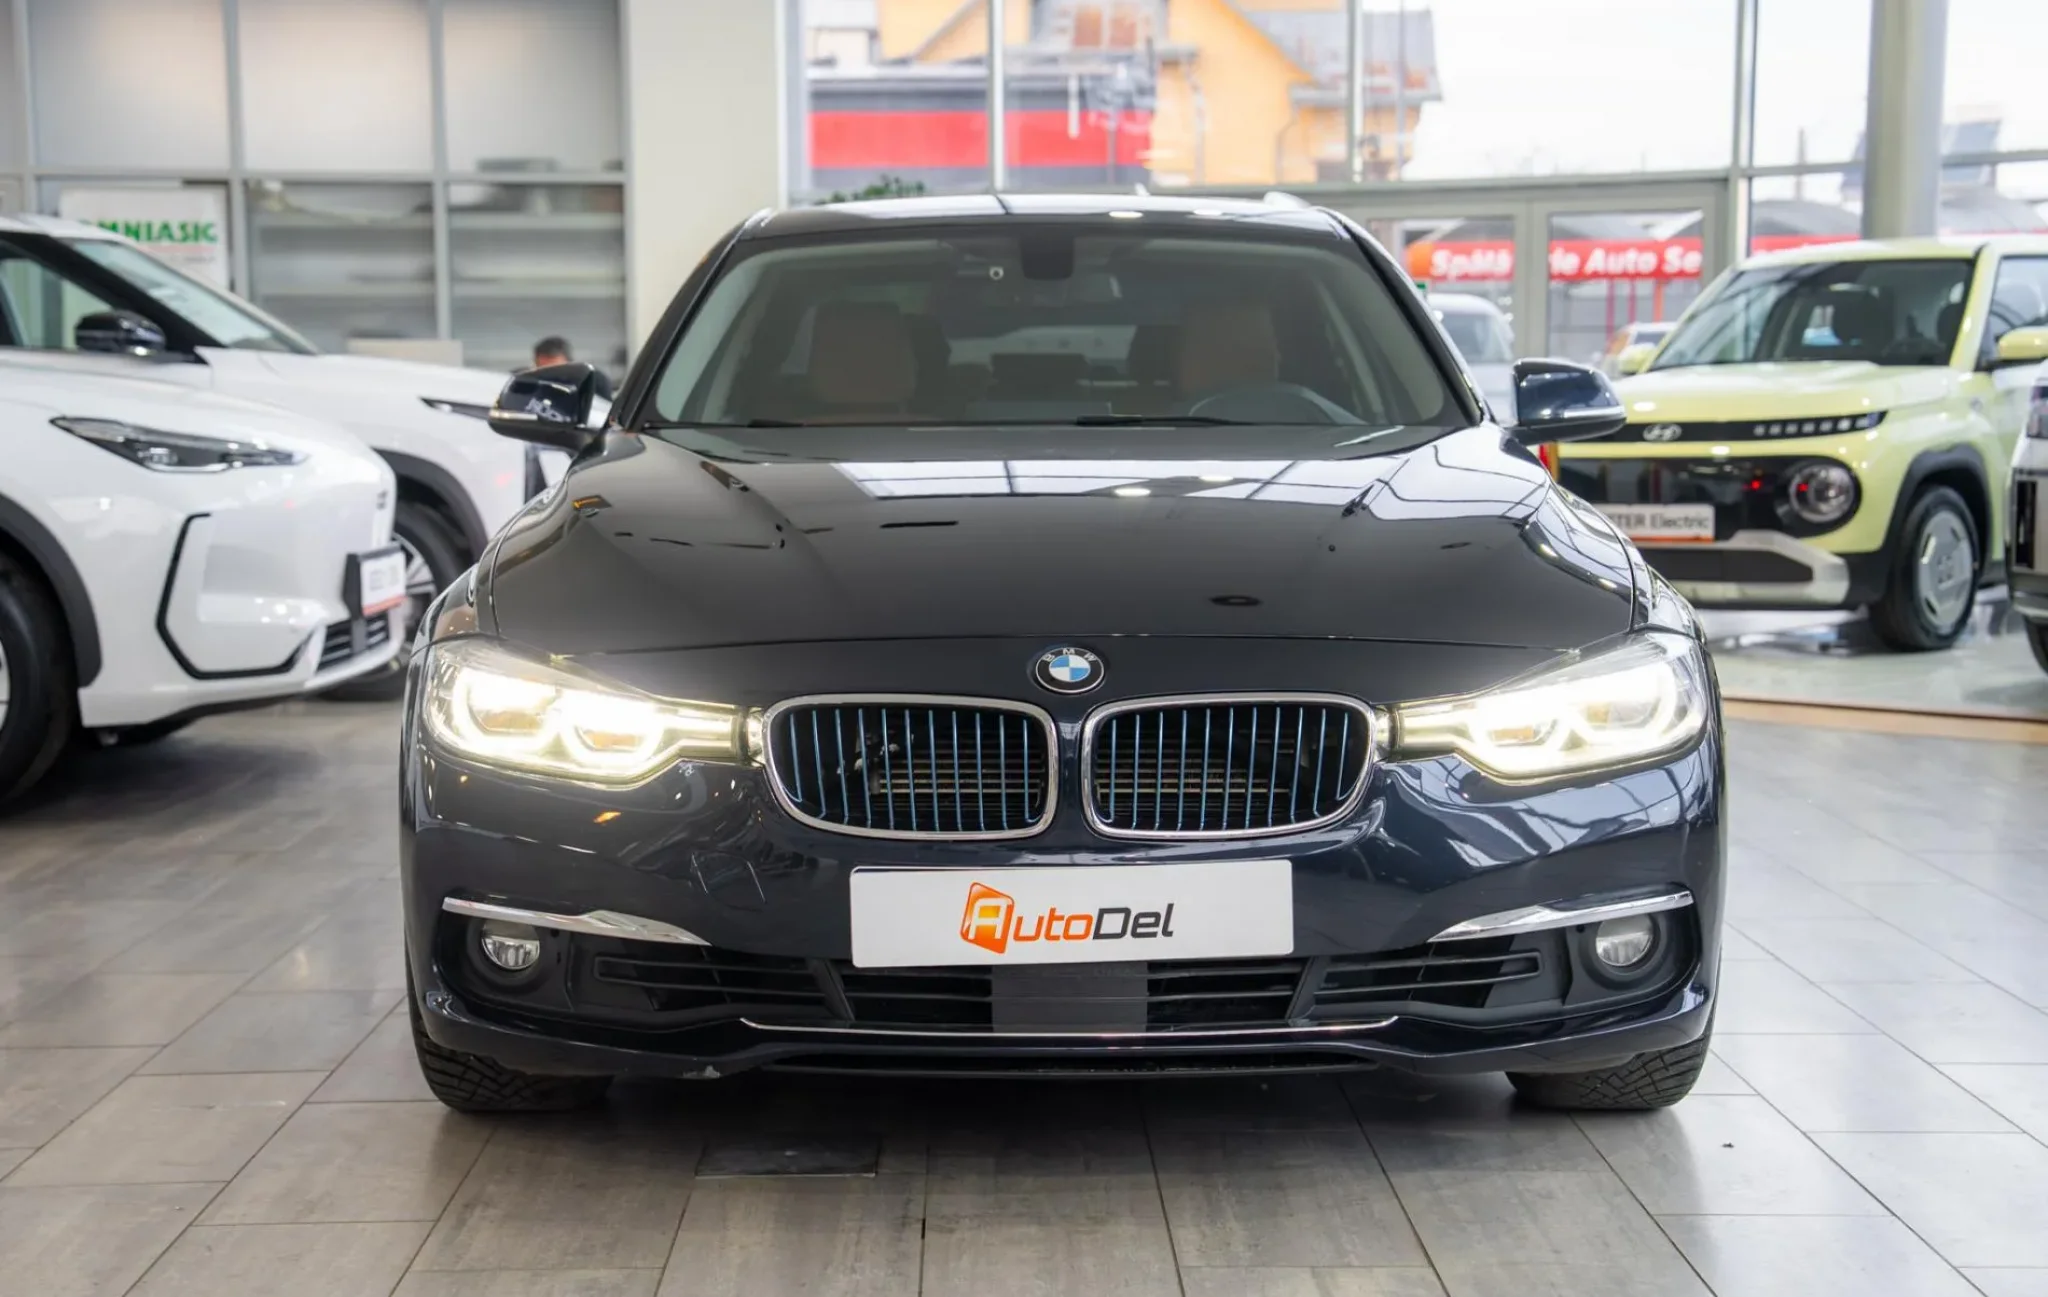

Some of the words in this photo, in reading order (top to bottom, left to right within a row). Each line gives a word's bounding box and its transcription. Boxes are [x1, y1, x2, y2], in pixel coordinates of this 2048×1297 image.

[1584, 248, 1658, 275] Auto
[1661, 245, 1703, 274] Se
[1651, 512, 1709, 530] Electric
[1042, 648, 1097, 662] BMW
[965, 895, 1175, 943] AutoDel
